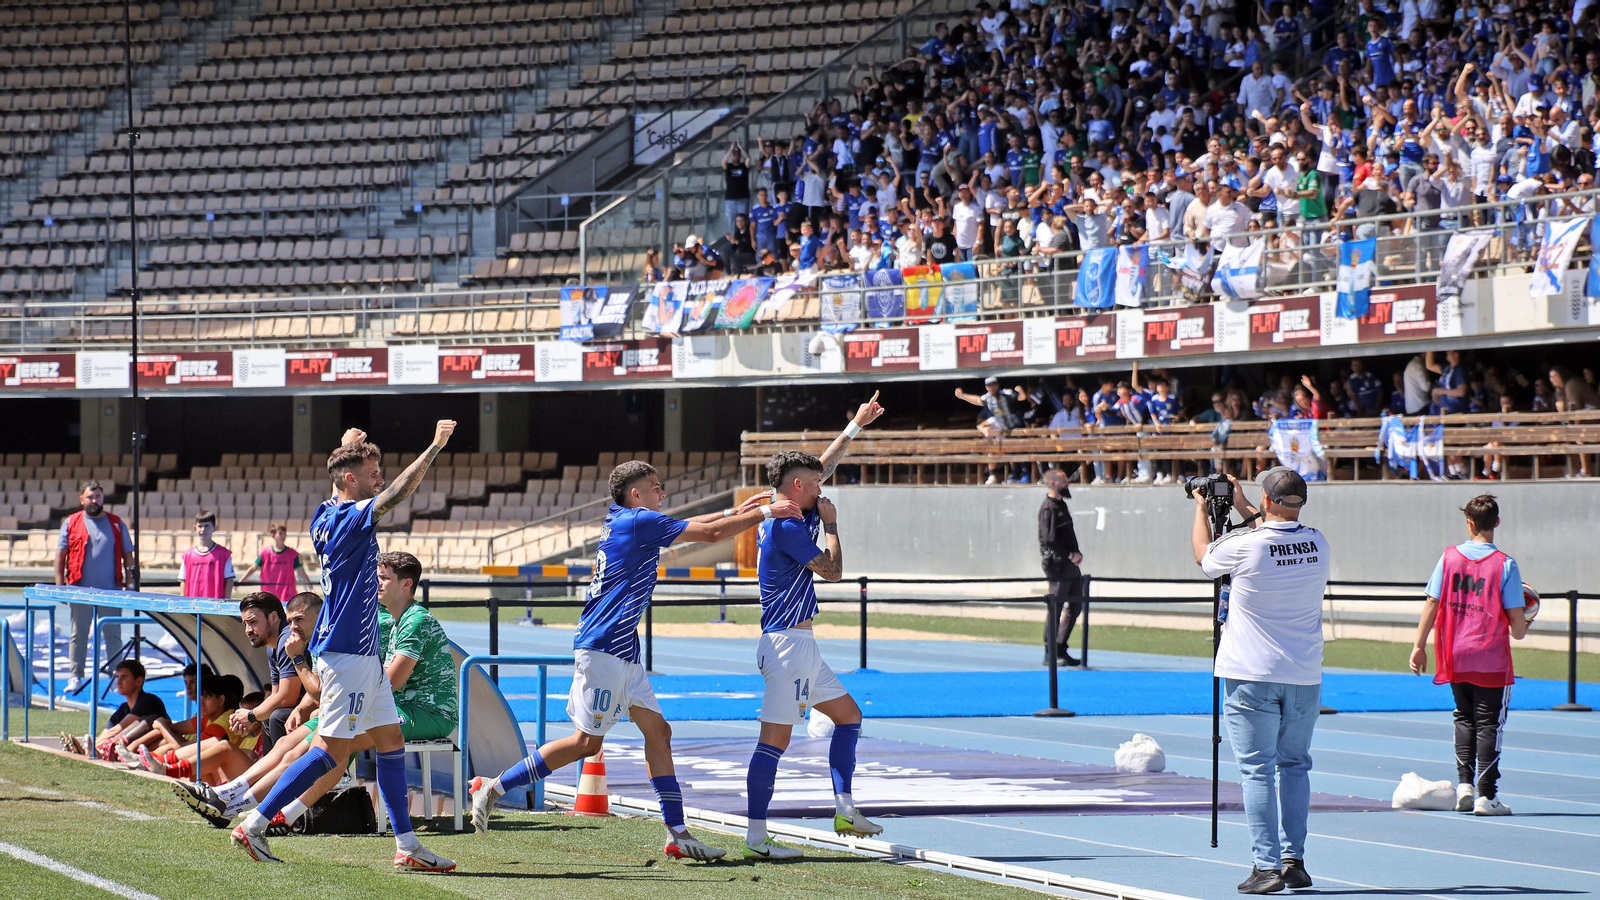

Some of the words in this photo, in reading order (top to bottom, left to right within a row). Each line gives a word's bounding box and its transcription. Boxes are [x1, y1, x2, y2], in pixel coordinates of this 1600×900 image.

[1269, 540, 1318, 557] PRENSA
[1276, 558, 1304, 566] XEREZ
[1306, 556, 1318, 564] CD
[592, 688, 612, 712] 10
[794, 678, 810, 701] 14
[348, 692, 365, 715] 16
